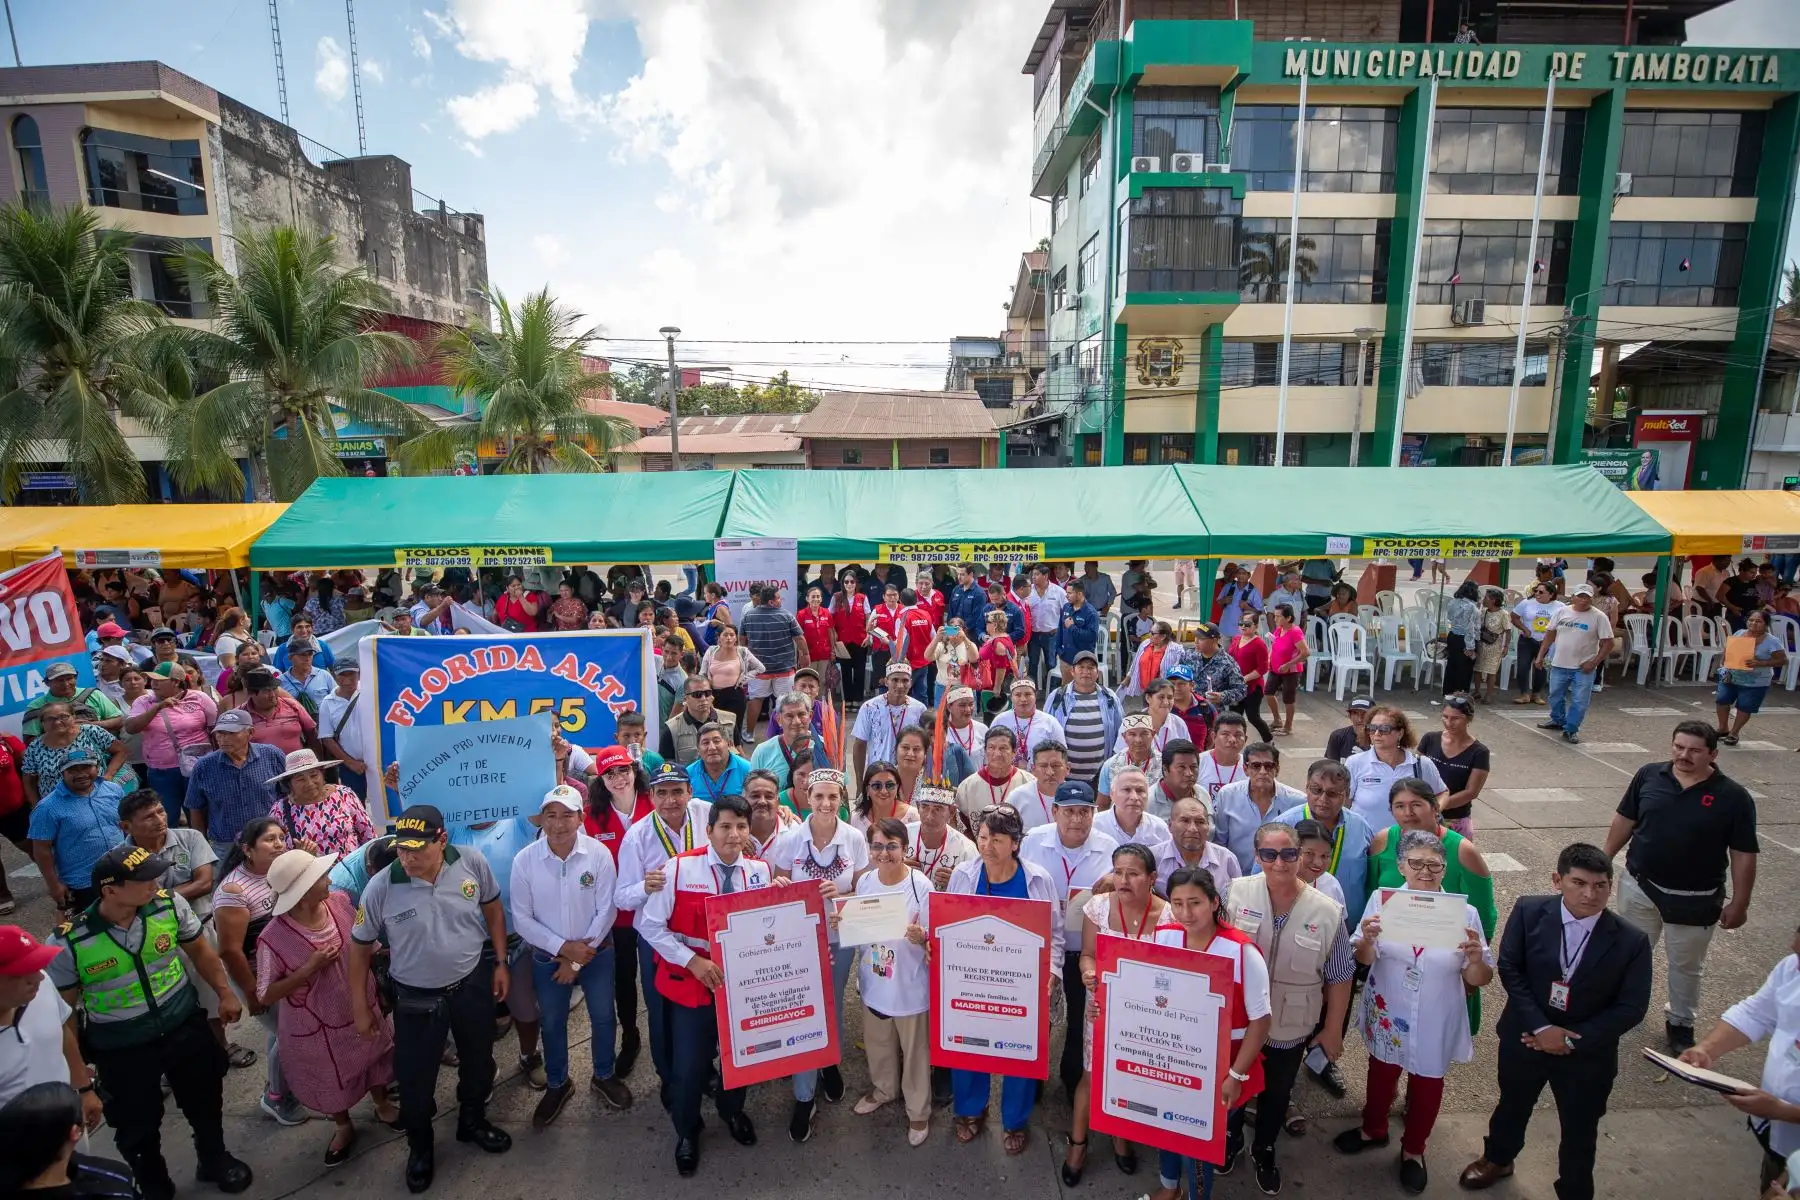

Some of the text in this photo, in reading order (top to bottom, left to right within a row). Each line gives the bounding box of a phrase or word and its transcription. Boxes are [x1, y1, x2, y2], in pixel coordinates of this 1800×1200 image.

[1285, 48, 1778, 83] MUNICIPALIDAD DE TAMBOPATA
[384, 644, 638, 727] FLORIDA ALTA
[442, 699, 516, 726] KM
[400, 734, 532, 800] ASOCIACION PRO VIVIENDA
[460, 760, 488, 770] 17 DE
[448, 773, 507, 787] OCTUBRE
[739, 941, 802, 959] Gobierno del Perú
[956, 942, 1022, 954] Gobierno del Perú
[754, 962, 792, 976] TÍTULO DE
[947, 964, 978, 973] TÍTULOS
[991, 969, 1032, 979] PROPIEDAD
[738, 972, 783, 987] AFECTACIÓN
[964, 974, 1014, 984] REGISTRADOS
[745, 994, 767, 1004] Puesto
[778, 985, 810, 997] vigilancia
[762, 996, 796, 1008] Seguridad
[955, 1002, 986, 1011] MADRE
[755, 1005, 788, 1015] Fronteras
[1124, 1002, 1198, 1023] Gobierno del Perú
[749, 1010, 806, 1027] SHIRINGAYOC
[795, 1031, 823, 1041] COFOPRI
[1140, 1026, 1169, 1038] TÍTULO
[1120, 1031, 1201, 1053] AFECTACIÓN EN USO
[1148, 1059, 1170, 1069] B-141
[1167, 1056, 1208, 1070] Bomberos
[1127, 1064, 1192, 1085] LABERINTO
[1174, 1114, 1207, 1127] COFOPRI
